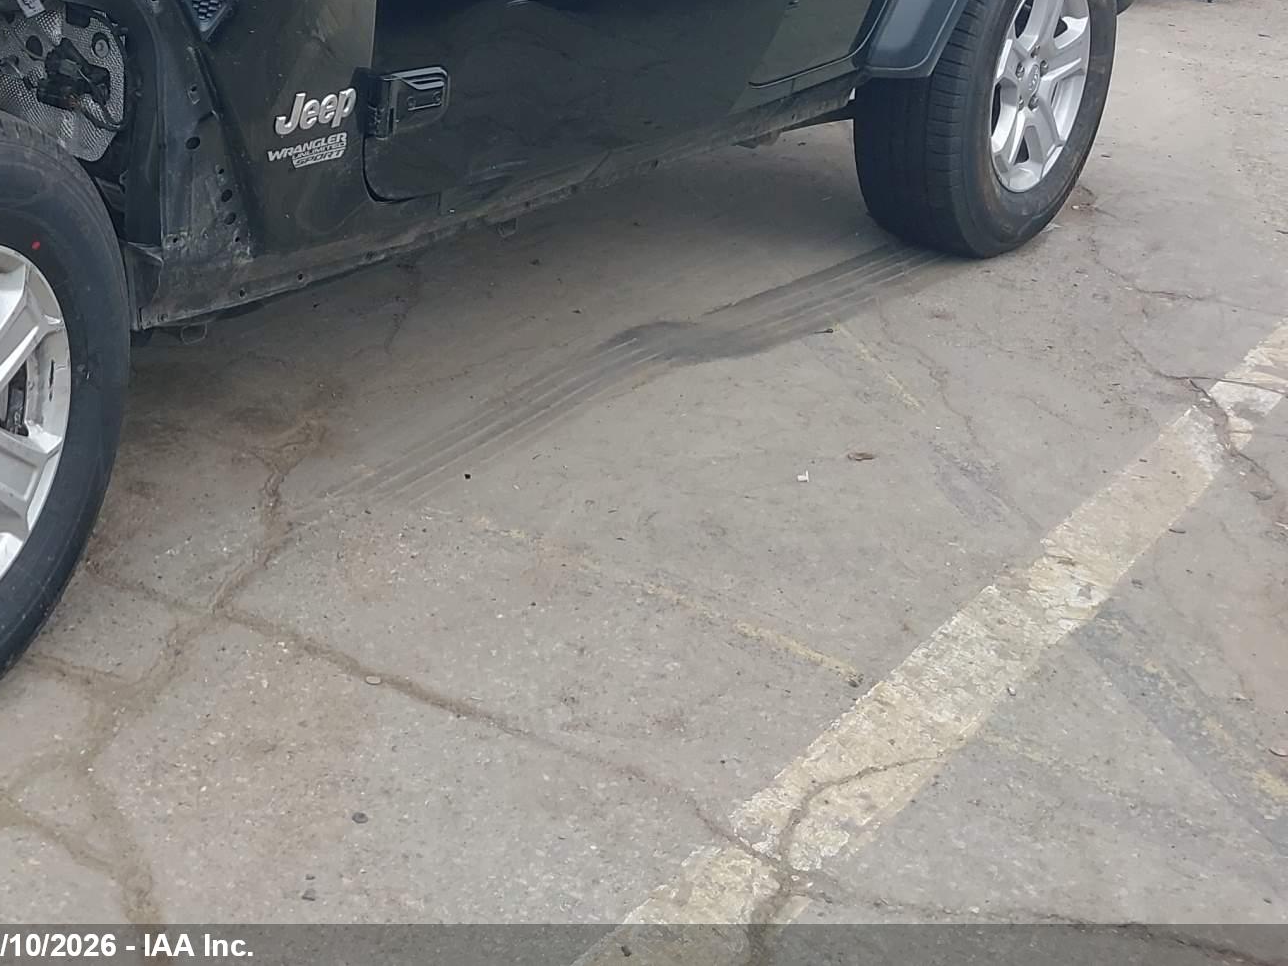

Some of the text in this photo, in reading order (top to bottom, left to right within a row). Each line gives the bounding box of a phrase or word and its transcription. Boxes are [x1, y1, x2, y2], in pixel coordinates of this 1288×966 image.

[275, 87, 357, 135] Jeep
[267, 132, 347, 162] WRANGLER
[291, 141, 347, 160] UNLIMITED
